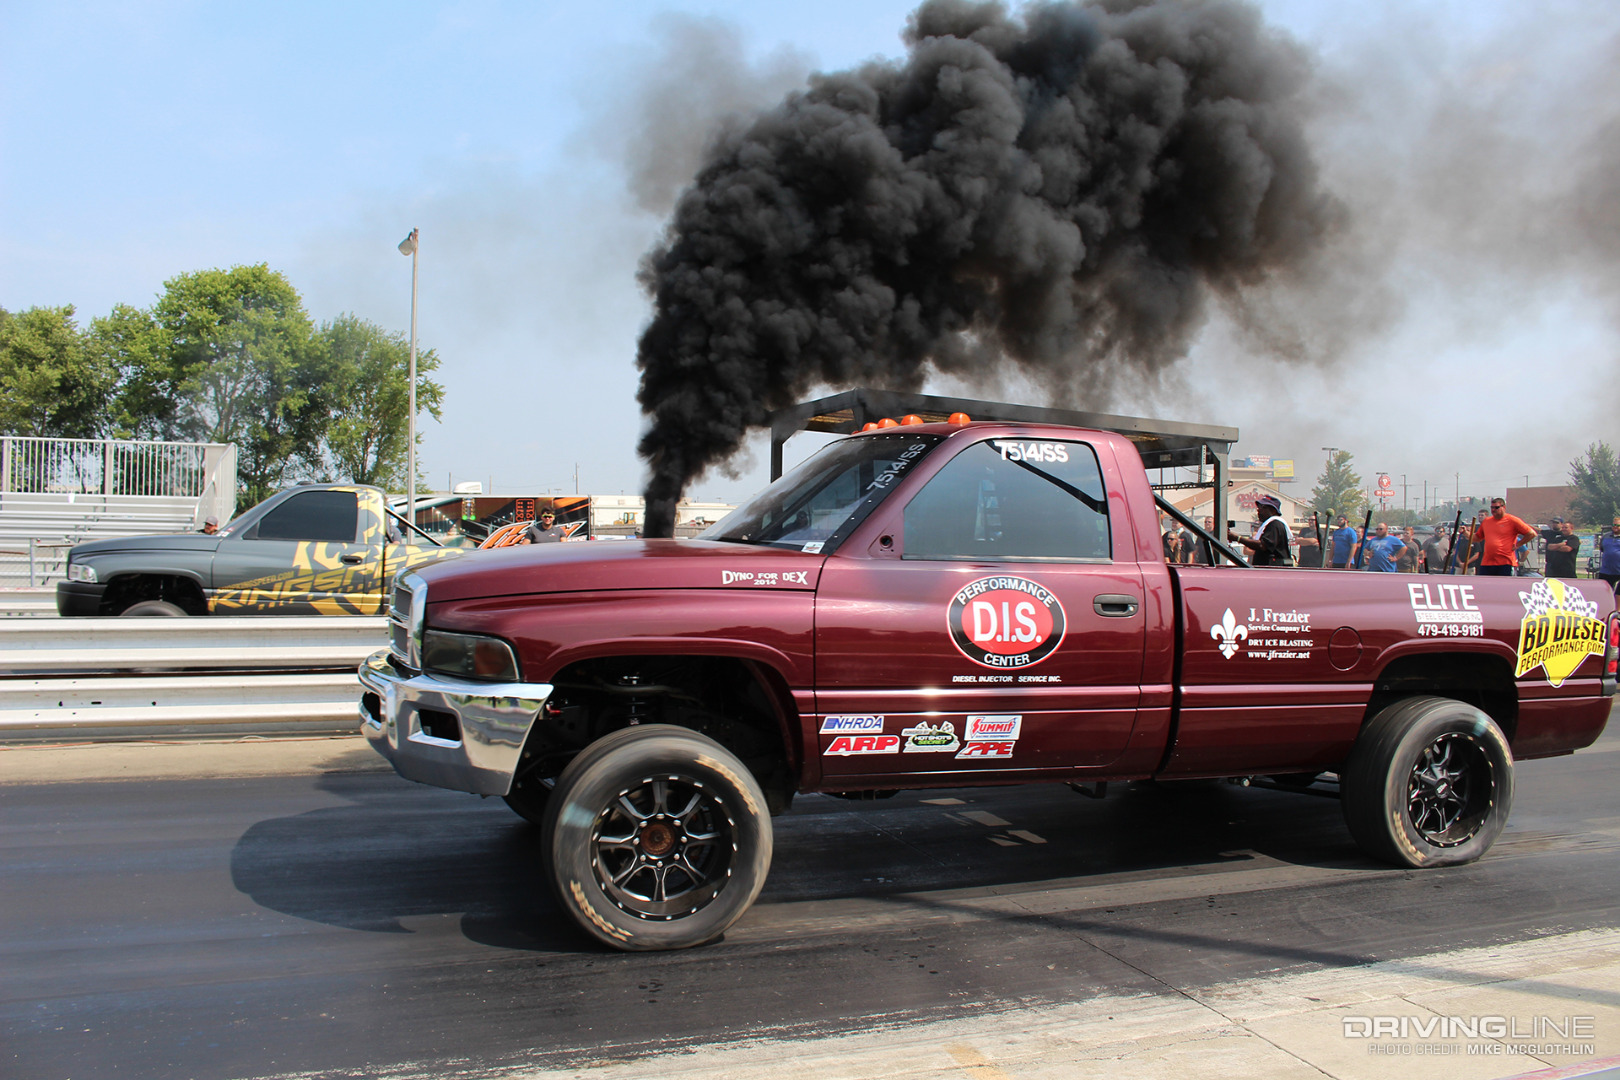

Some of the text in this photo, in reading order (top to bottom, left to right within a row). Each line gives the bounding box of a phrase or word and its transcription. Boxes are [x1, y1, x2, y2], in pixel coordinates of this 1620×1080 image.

[994, 441, 1068, 462] 7514/SS
[867, 443, 926, 491] 7514/SS
[722, 570, 809, 585] DYNO FOR DEX
[957, 578, 1055, 608] PERFORMANCE
[1407, 583, 1479, 610] ELITE
[973, 601, 1043, 643] D.I.S.
[1247, 608, 1311, 623] J. Frazier
[1271, 624, 1300, 633] Company
[1417, 624, 1483, 636] 479-419-9181
[1522, 616, 1605, 655] BD DIESEL
[1279, 639, 1313, 647] BLASTING
[984, 653, 1030, 666] CENTER
[1247, 650, 1311, 660] www.jfrazier.net
[833, 718, 882, 729] NHRDA
[828, 737, 898, 752] ARP
[962, 742, 1013, 756] PPE
